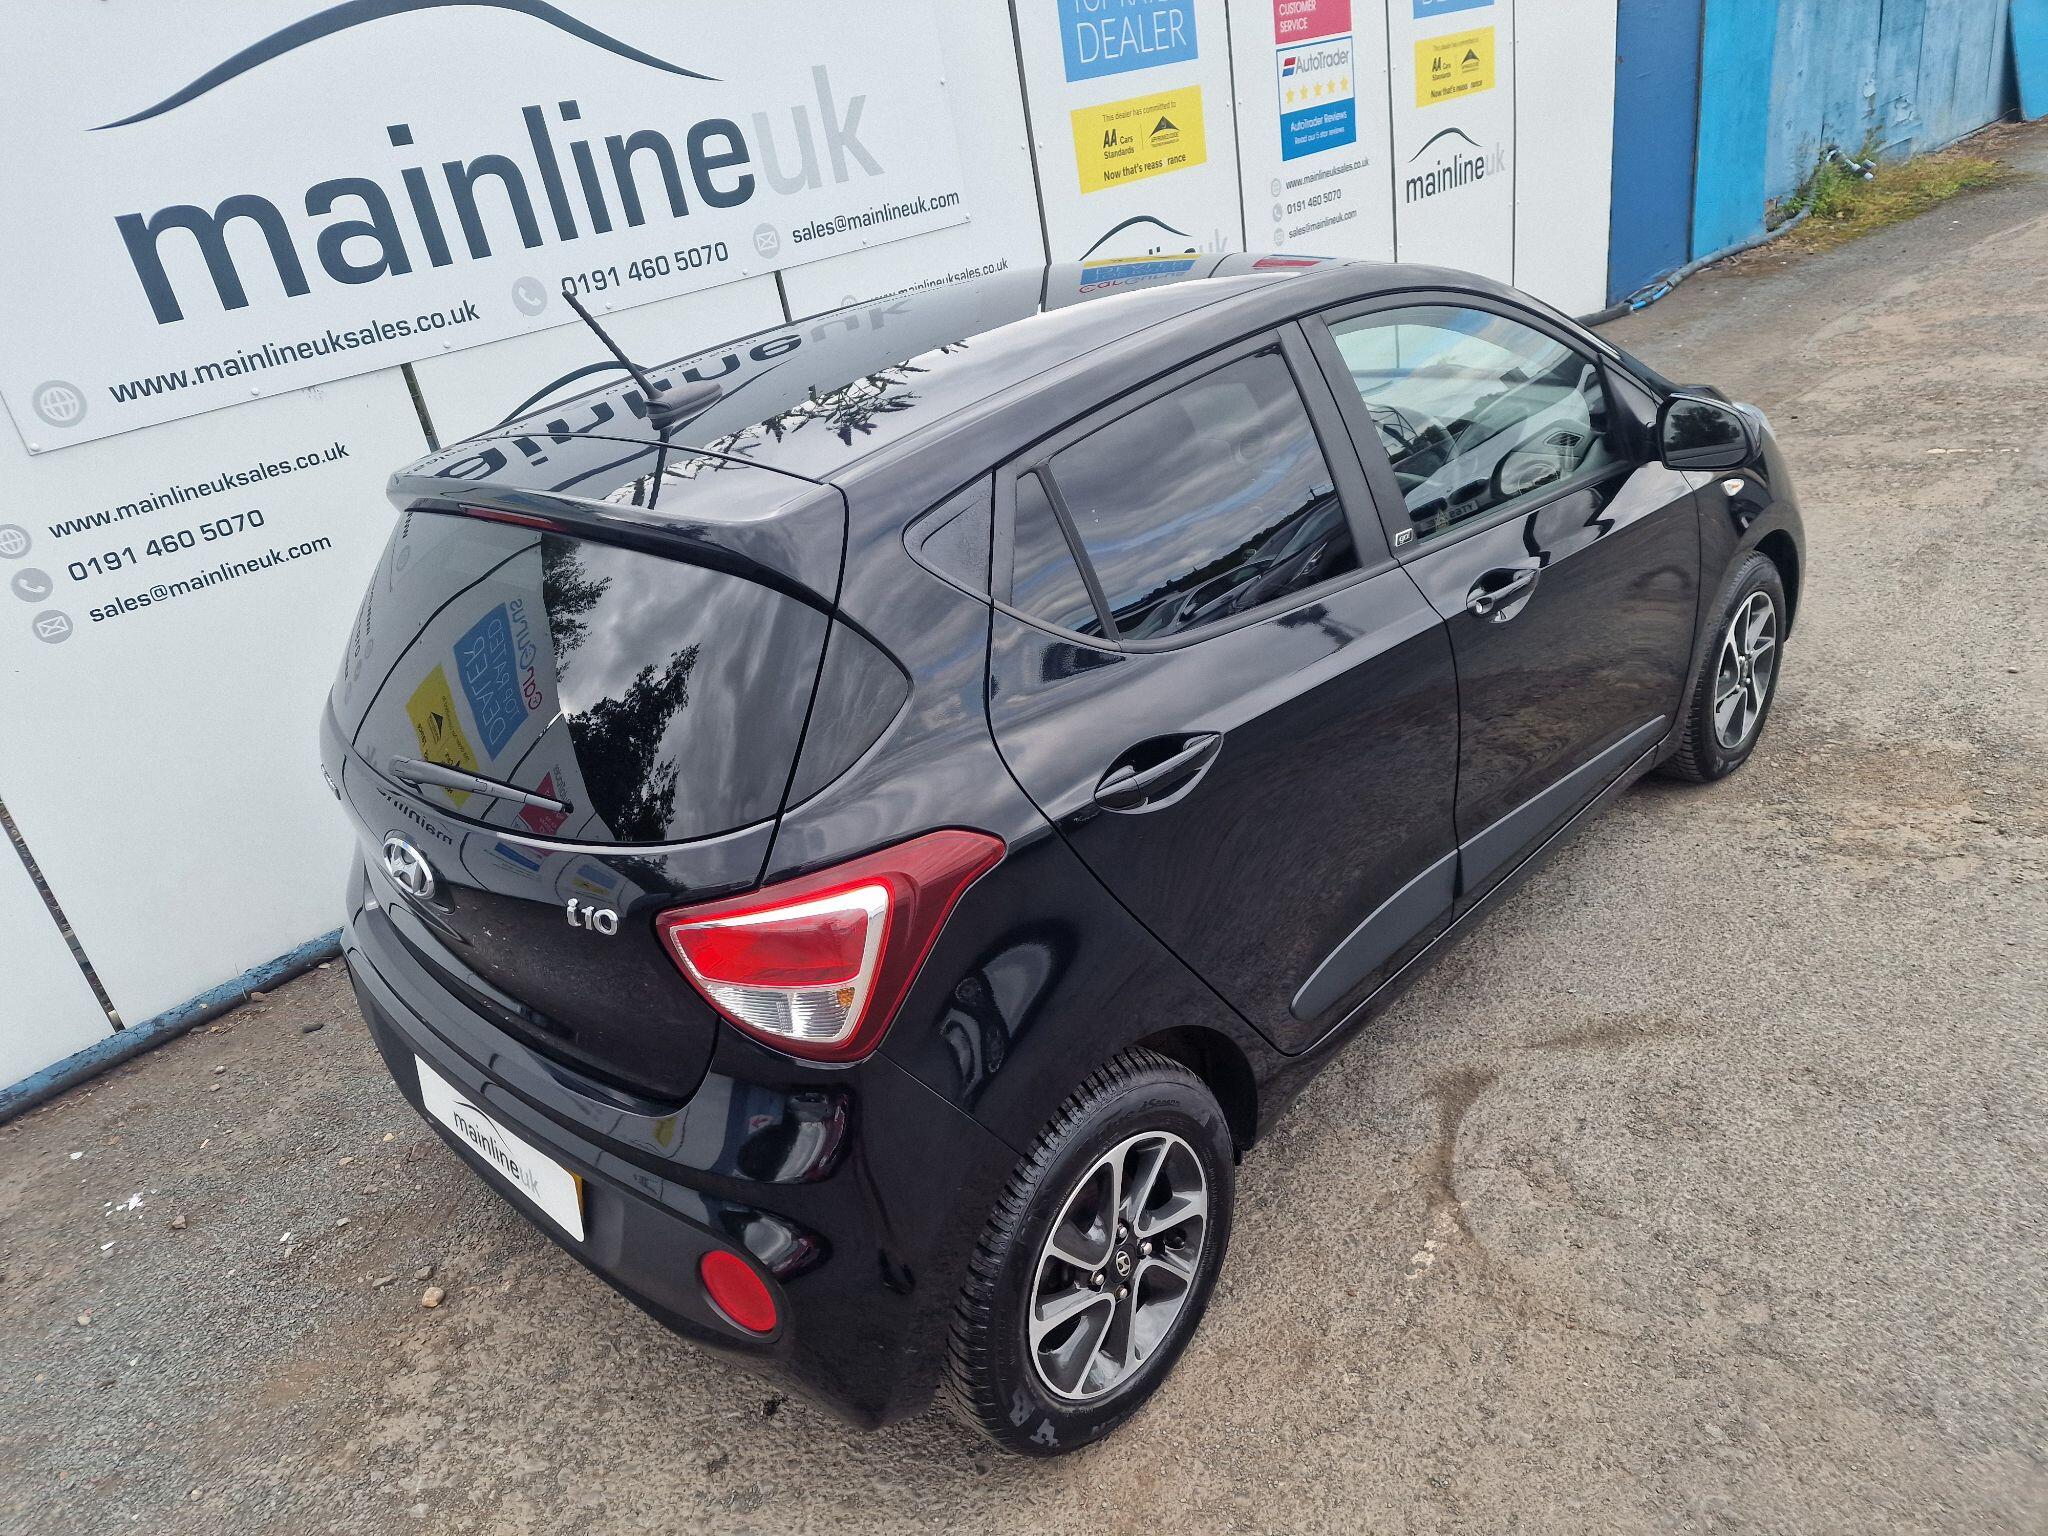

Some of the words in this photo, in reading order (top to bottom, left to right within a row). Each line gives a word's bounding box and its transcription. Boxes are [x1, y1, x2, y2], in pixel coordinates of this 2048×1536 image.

[1077, 9, 1187, 63] DEALER
[1280, 17, 1308, 32] SERVICE
[1296, 48, 1349, 74] AutoTrader
[1103, 128, 1118, 149] AA
[1119, 136, 1133, 145] Cars
[1103, 146, 1135, 160] Standards
[114, 64, 885, 325] mainlineuk
[1103, 169, 1121, 181] Now
[1122, 163, 1142, 177] that's
[1406, 141, 1505, 203] mainlineuk
[792, 191, 960, 243] sales@mainlineuk.com
[1287, 200, 1306, 215] 0191
[1307, 195, 1322, 208] 460
[1323, 189, 1341, 203] 5070
[561, 265, 621, 297] 0191
[628, 253, 670, 281] 460
[674, 241, 729, 272] 5070
[108, 299, 480, 403] www.mainlineuksales.co.uk
[48, 442, 350, 539] www.mainlineuksales.co.uk
[67, 546, 138, 582] 0191
[146, 529, 196, 558] 460
[200, 509, 265, 542] 5070
[89, 536, 332, 623] sales@mainlineuk.com
[567, 898, 618, 936] i10
[453, 1110, 541, 1199] mainlineuk
